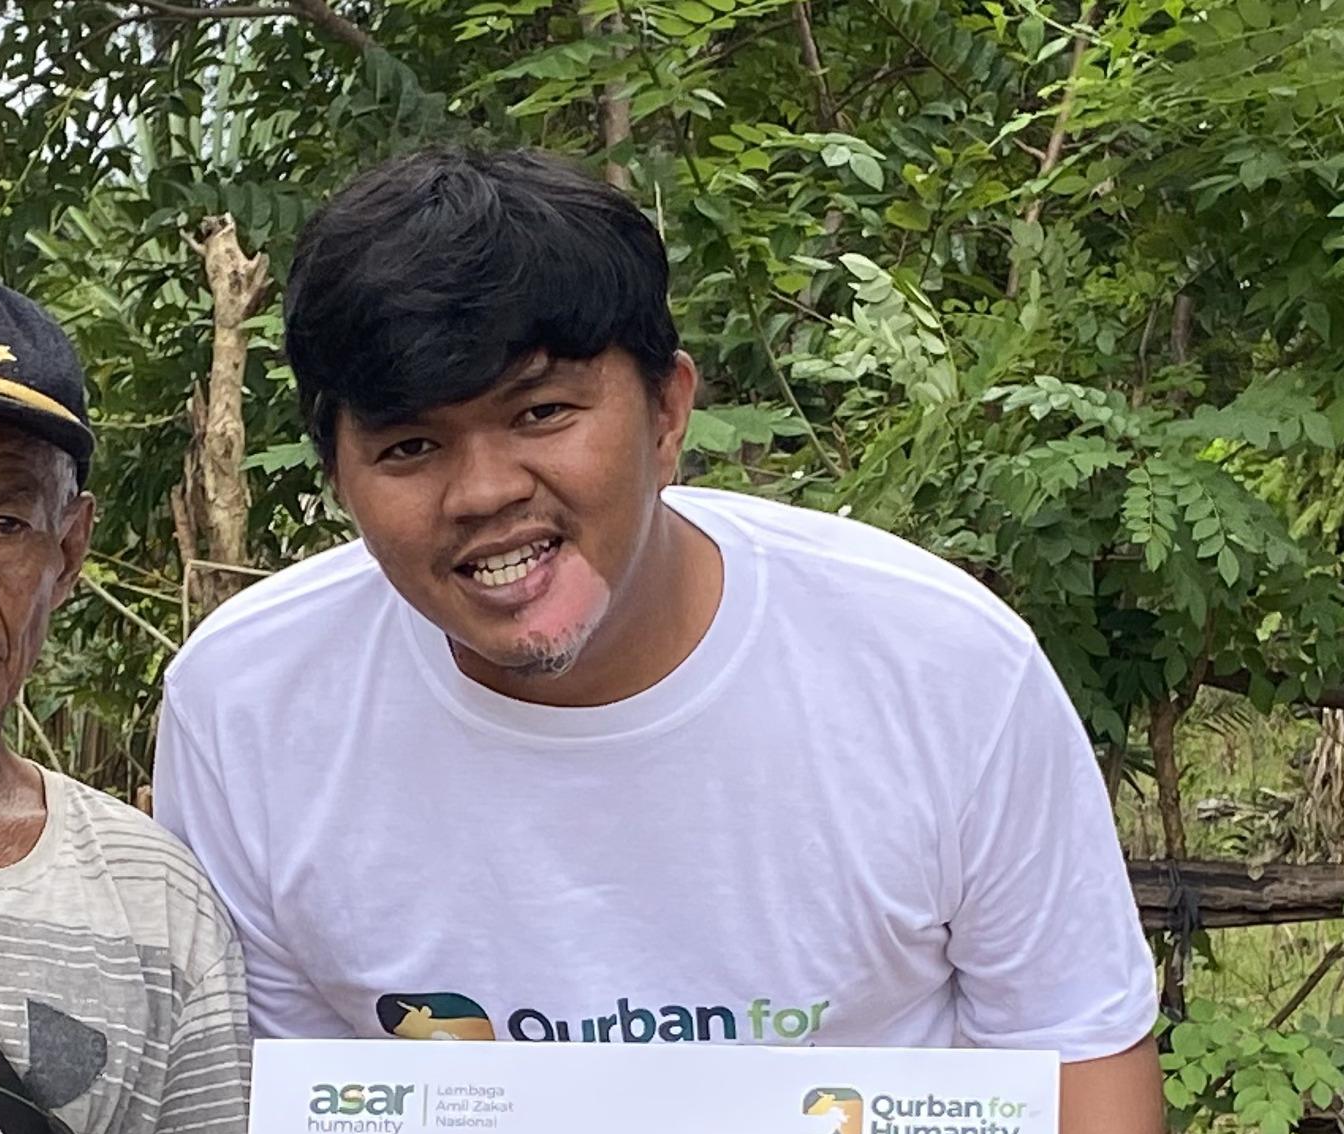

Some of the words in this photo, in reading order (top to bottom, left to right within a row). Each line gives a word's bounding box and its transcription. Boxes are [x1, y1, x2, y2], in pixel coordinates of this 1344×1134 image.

[747, 998, 829, 1038] for
[309, 1083, 415, 1115] asar
[436, 1084, 505, 1099] Lembaga
[435, 1100, 468, 1113] Amil
[472, 1100, 514, 1113] Zakat
[870, 1093, 983, 1121] Qurban
[989, 1097, 1027, 1118] for
[435, 1115, 497, 1128] Nasional
